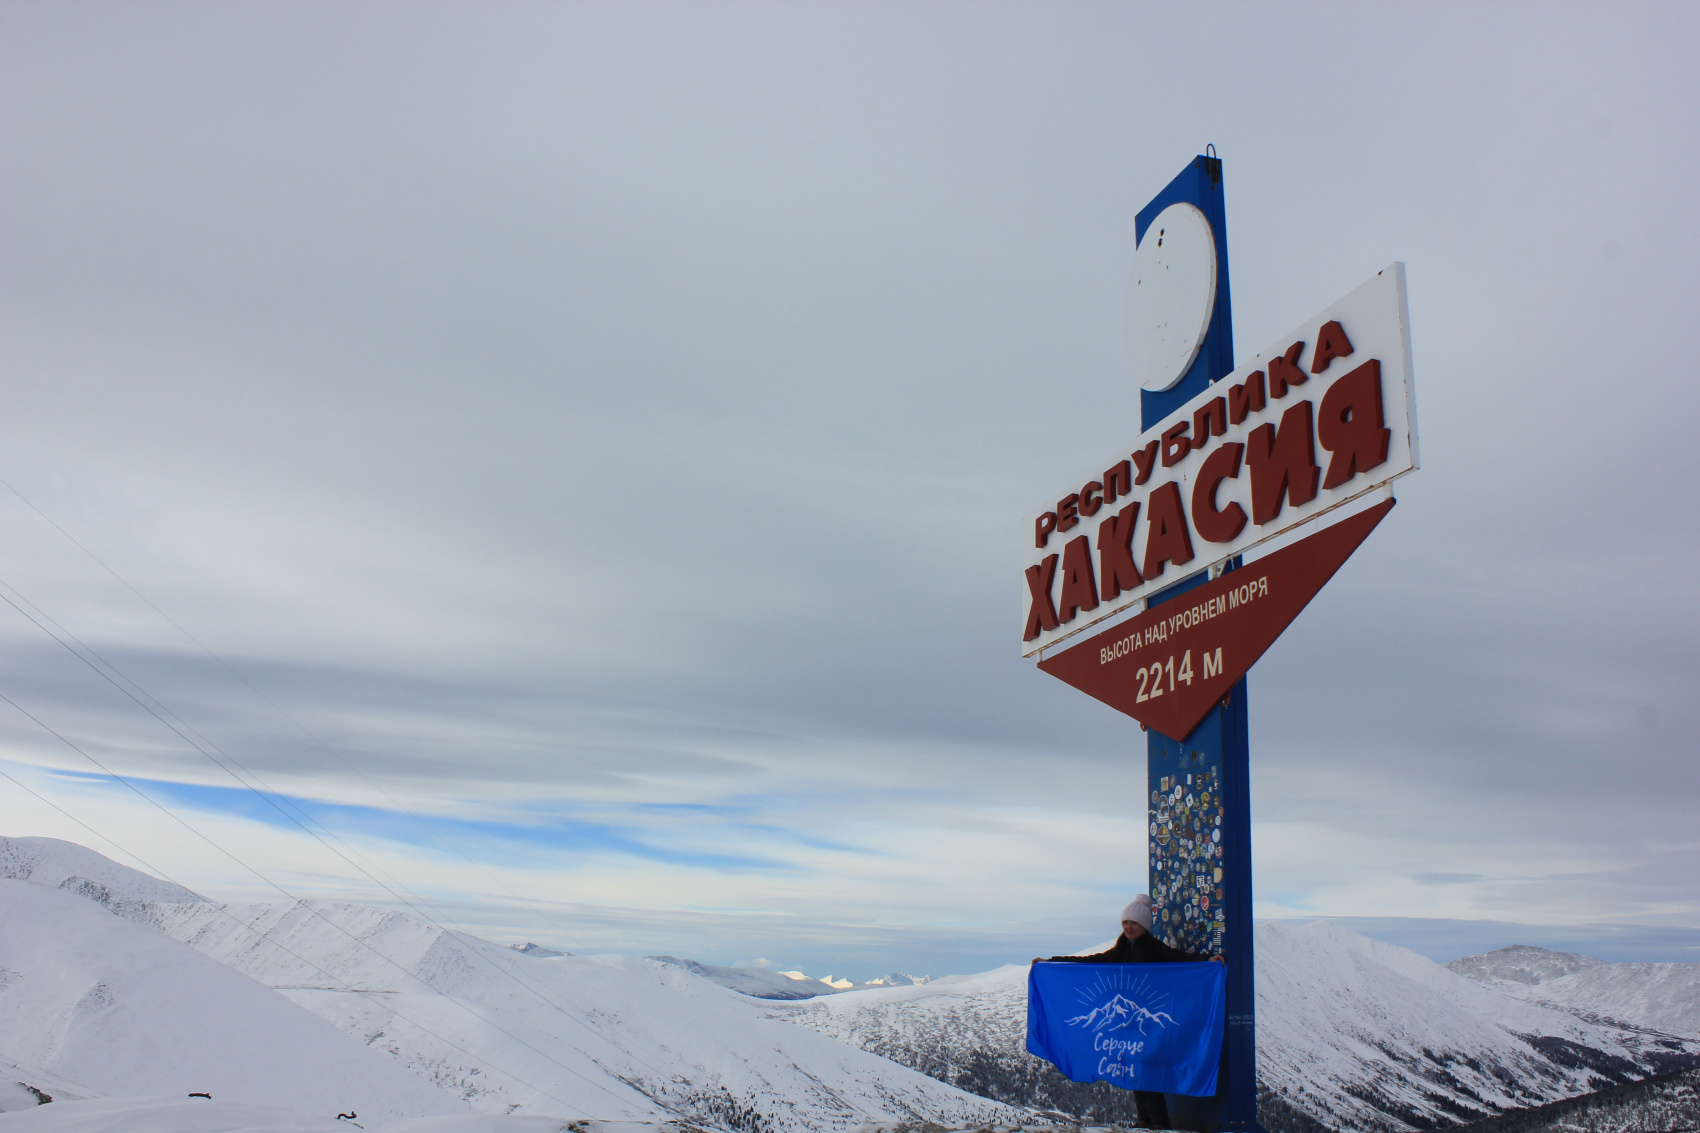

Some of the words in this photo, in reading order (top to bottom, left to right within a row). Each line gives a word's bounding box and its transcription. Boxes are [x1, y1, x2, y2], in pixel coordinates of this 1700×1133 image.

[1035, 320, 1354, 548] РЕСПУБЛИКА
[1023, 358, 1390, 642] ХАКАСИЯ
[1100, 632, 1142, 665] ВЫСОТА
[1144, 621, 1168, 646] НАД
[1168, 595, 1226, 635] УРОВНЕМ
[1228, 576, 1268, 611] МОРЯ
[1135, 649, 1194, 704] 2214
[1094, 1032, 1144, 1060] Сердце
[1098, 1056, 1135, 1078] Саян
